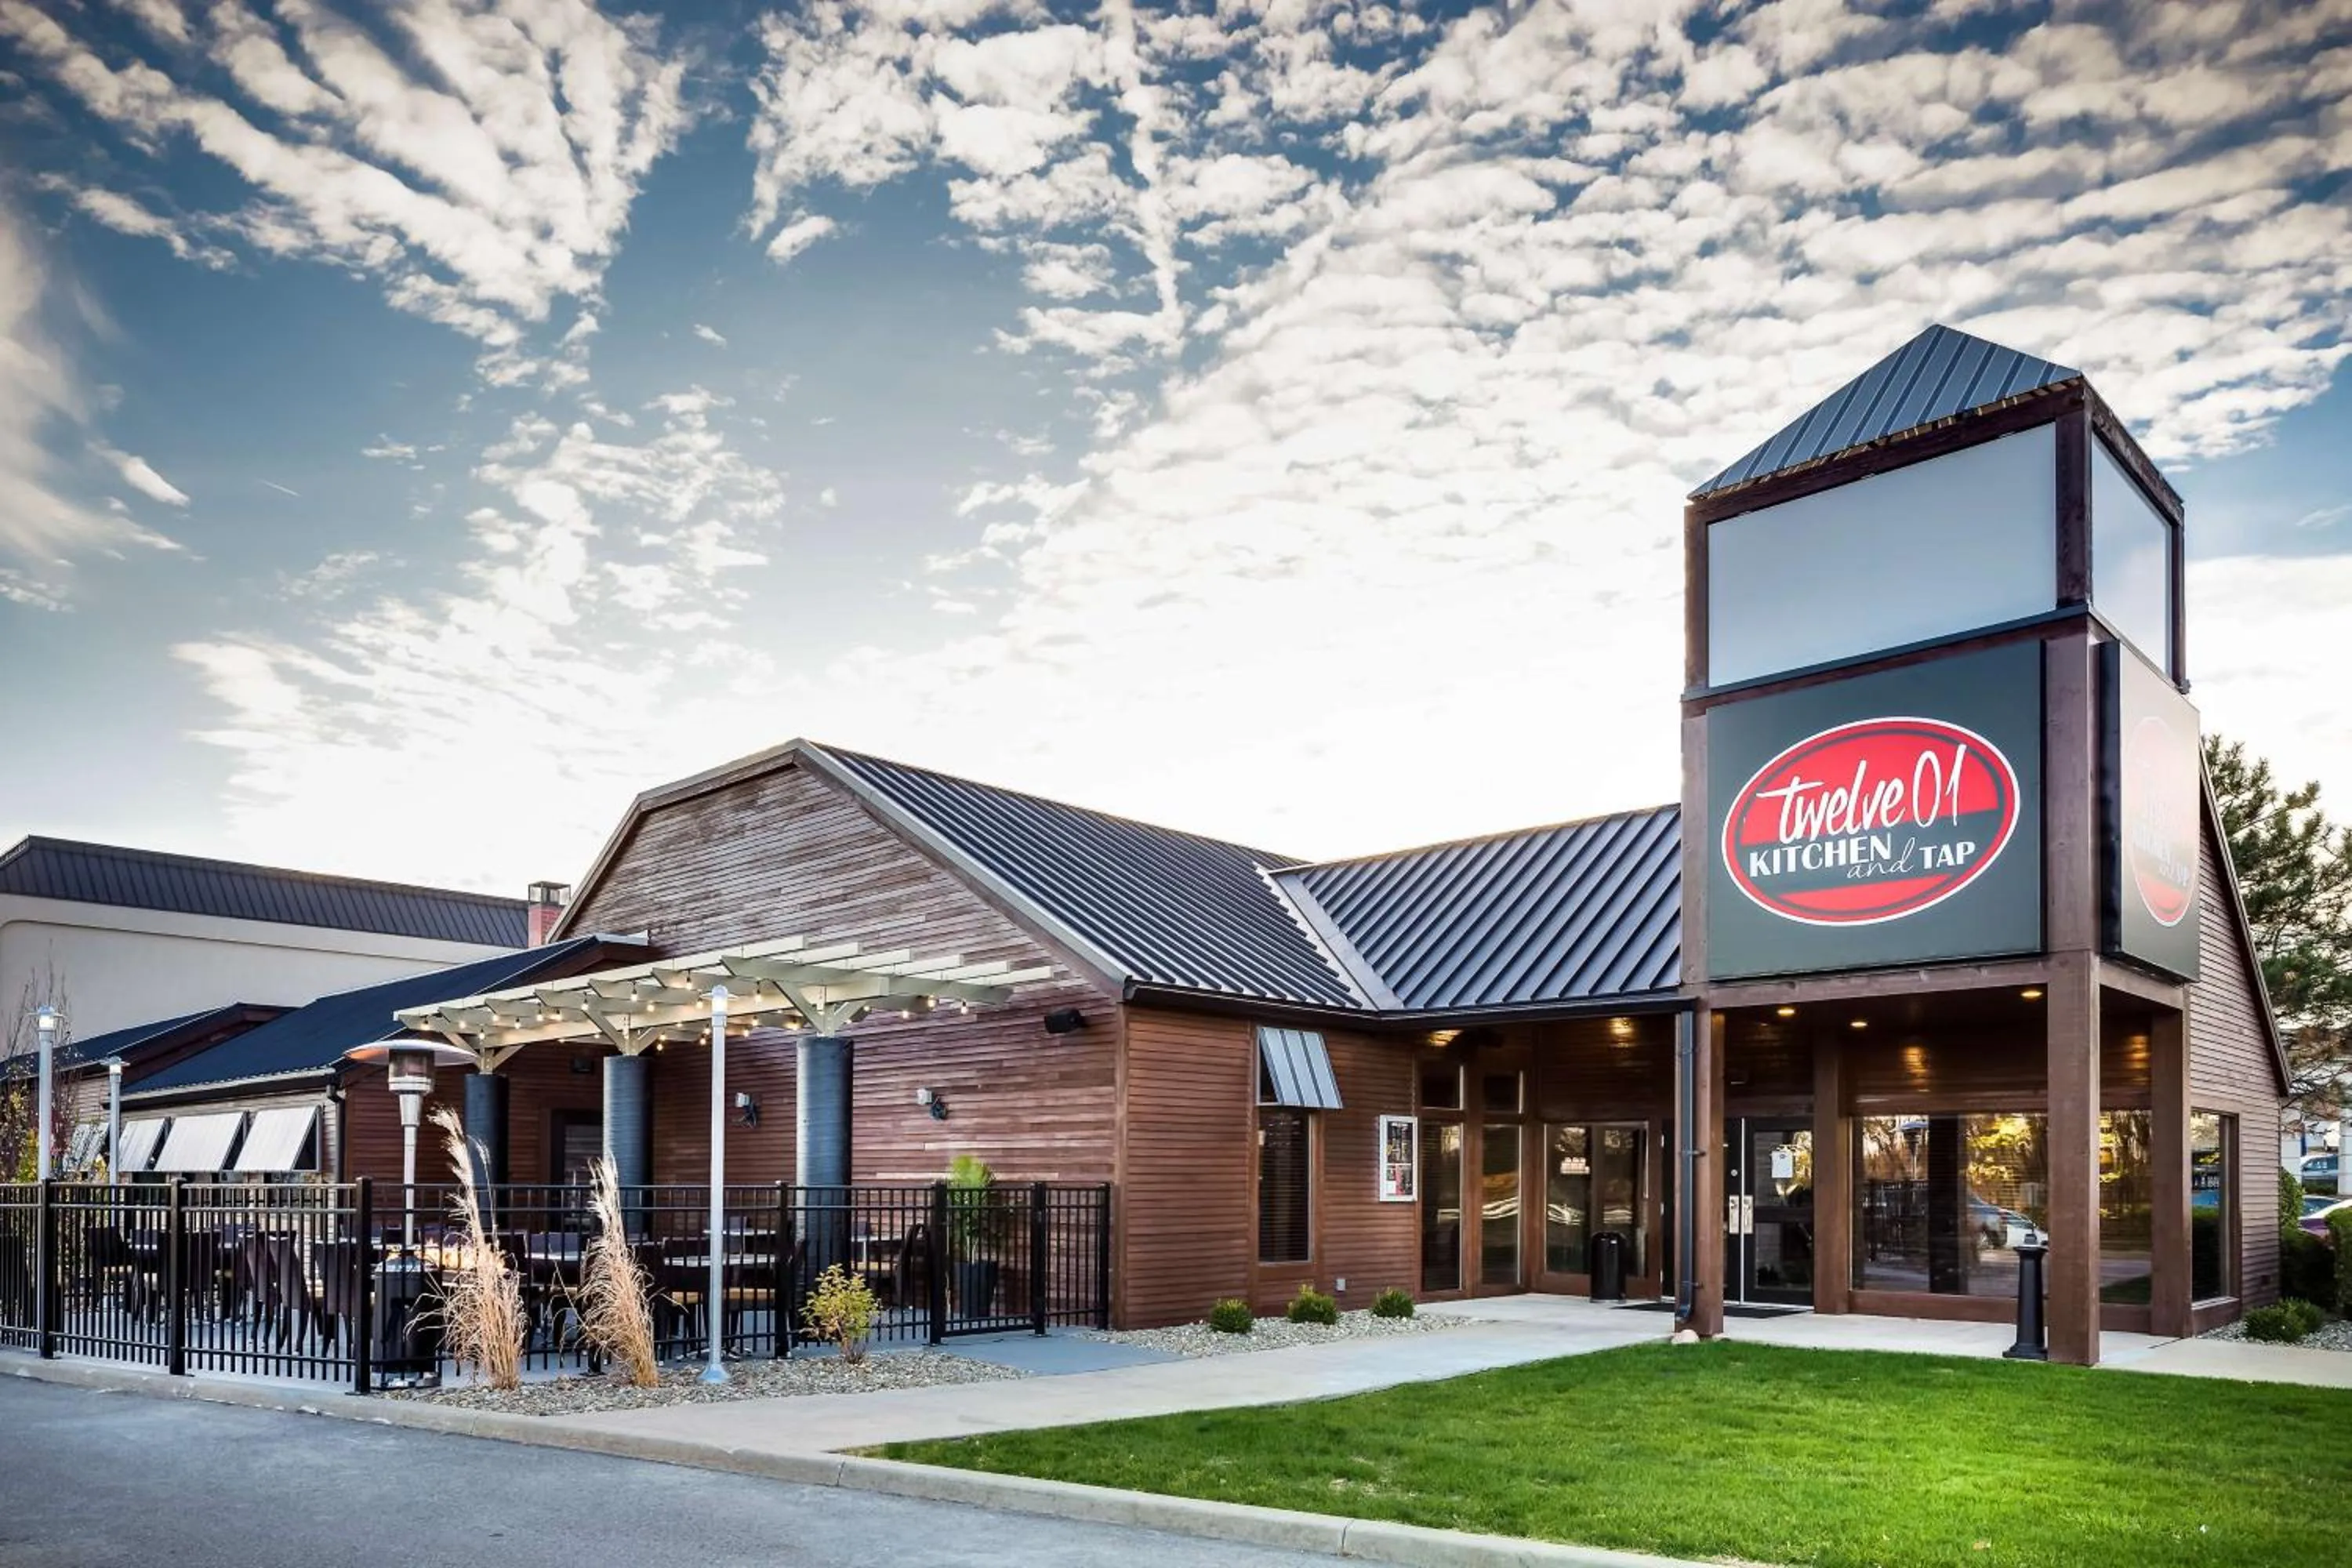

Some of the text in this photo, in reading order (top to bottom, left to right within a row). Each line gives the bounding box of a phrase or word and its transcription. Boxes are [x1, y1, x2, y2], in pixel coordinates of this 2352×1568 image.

[1913, 743, 1967, 827] 01
[1749, 833, 1976, 879] KITCHEN and TAP
